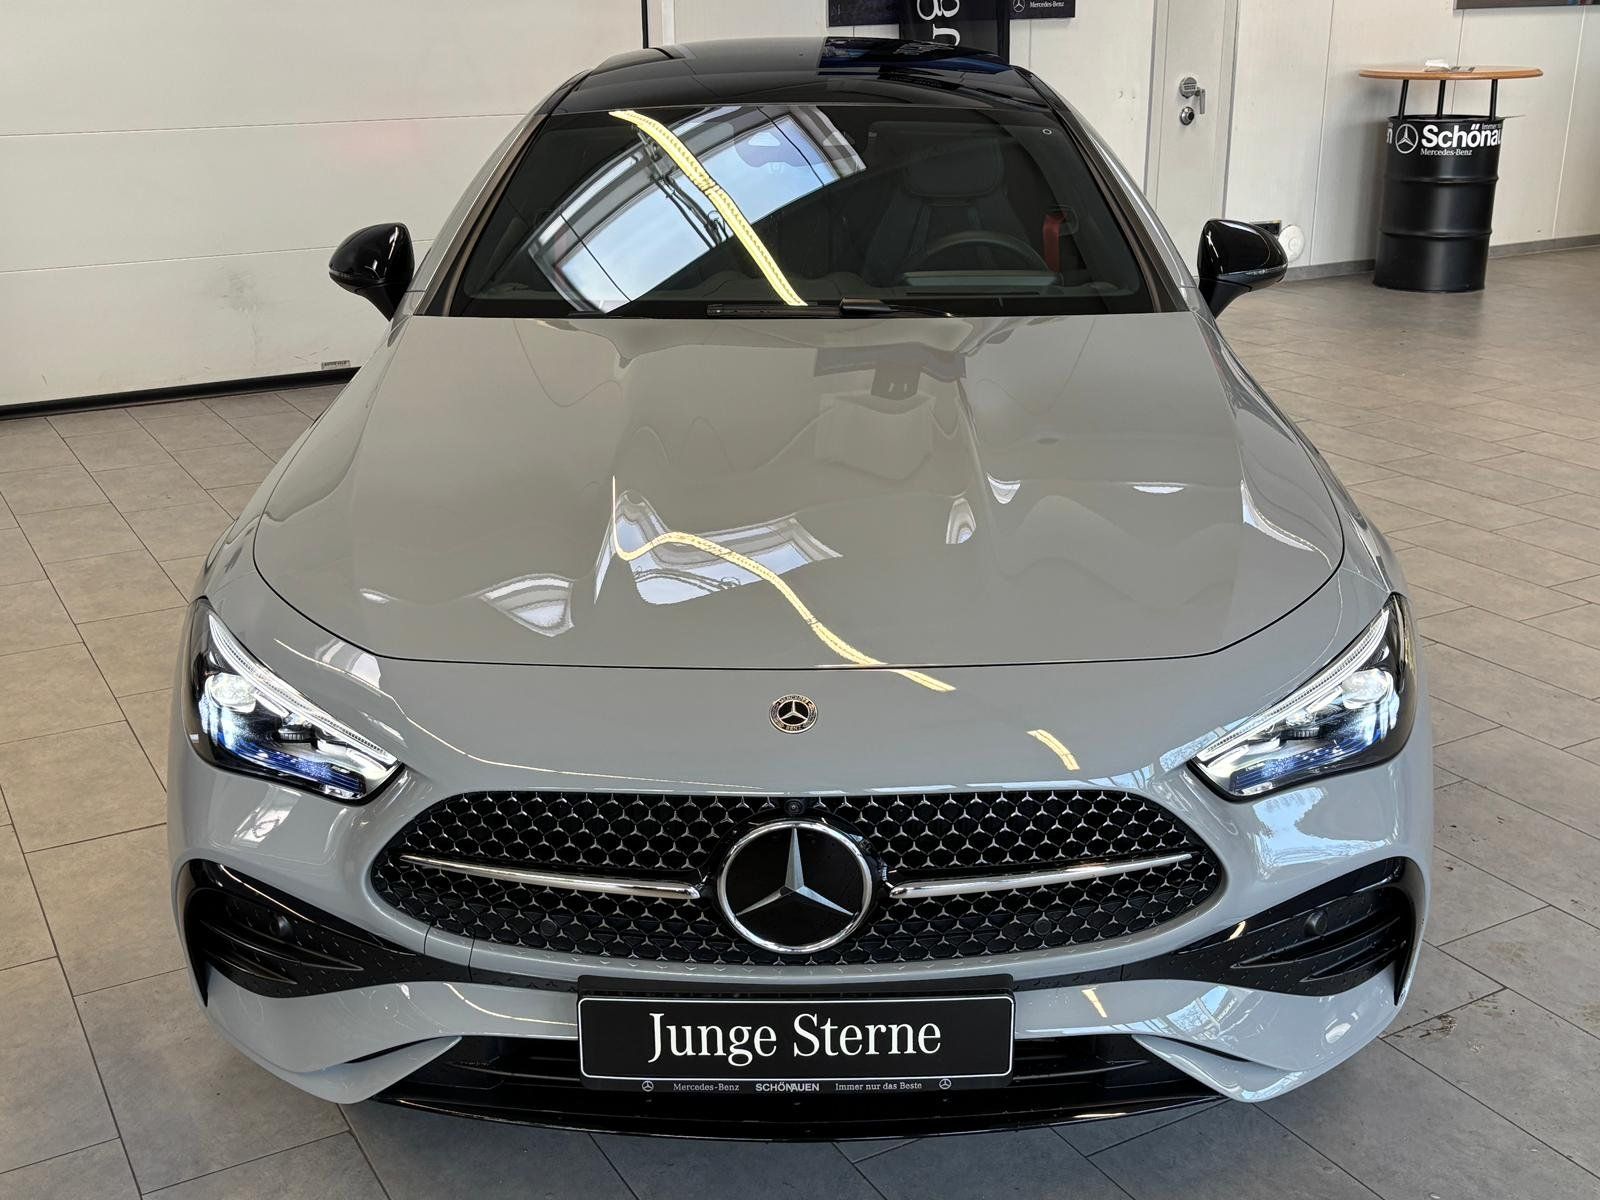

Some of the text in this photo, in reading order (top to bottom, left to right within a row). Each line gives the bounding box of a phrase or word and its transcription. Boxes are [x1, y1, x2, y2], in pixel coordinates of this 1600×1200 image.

[648, 1012, 941, 1067] Junge Sterne
[673, 1083, 740, 1092] Mercedes-Benz
[755, 1081, 820, 1092] SCHÖNAUEN
[835, 1083, 863, 1091] Immer
[882, 1082, 898, 1090] das
[900, 1081, 923, 1090] Beste
